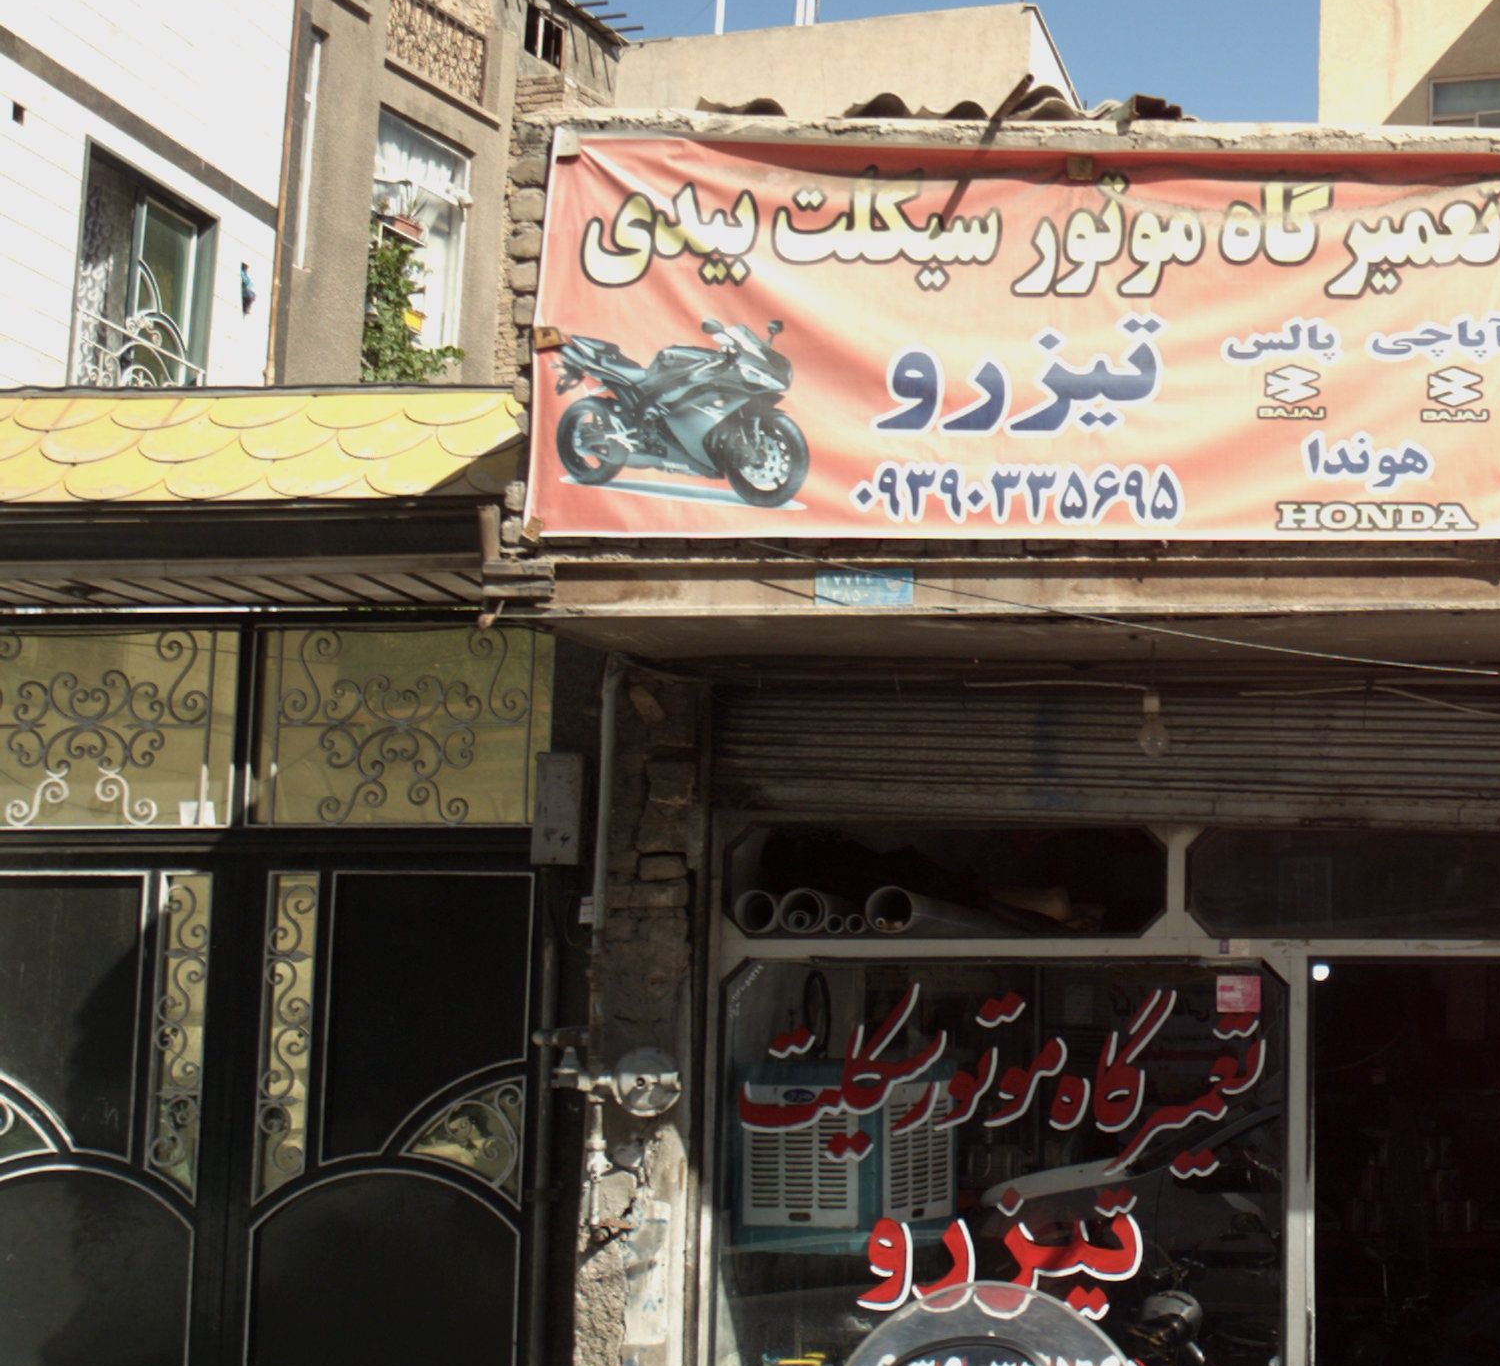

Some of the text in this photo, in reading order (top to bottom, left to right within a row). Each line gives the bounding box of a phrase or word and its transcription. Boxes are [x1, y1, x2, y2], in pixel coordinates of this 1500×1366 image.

[771, 165, 1003, 291] سیکلت
[1011, 172, 1206, 298] موتور
[1218, 179, 1333, 265] گاه
[1226, 323, 1335, 361] پالس
[1257, 406, 1327, 420] BAJAJ
[1420, 409, 1490, 423] BAJAJ
[856, 467, 1178, 520] ۰۹۳۹۰۳۳۵۶۹۵
[1308, 437, 1429, 487] هوندا
[1276, 501, 1479, 531] HONDA
[891, 991, 1068, 1137] موتور
[1048, 989, 1177, 1133] گاه
[1103, 1011, 1266, 1179] تعمیر
